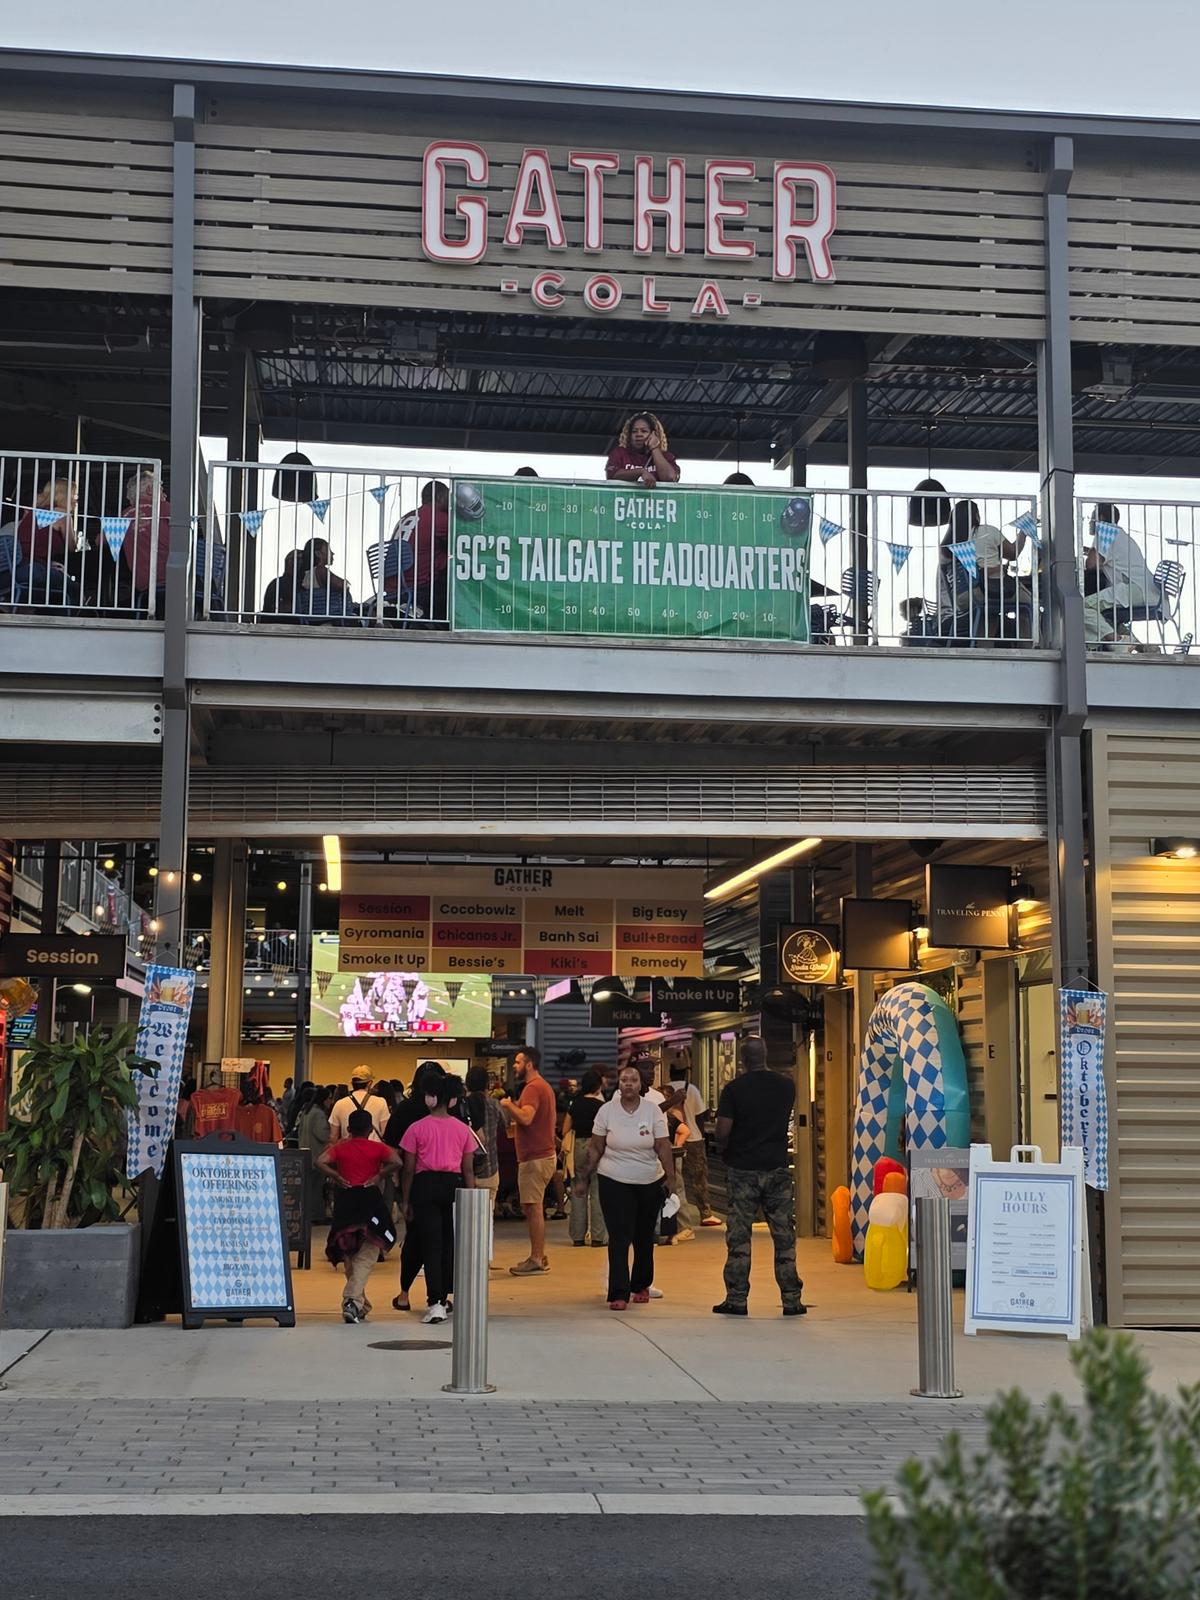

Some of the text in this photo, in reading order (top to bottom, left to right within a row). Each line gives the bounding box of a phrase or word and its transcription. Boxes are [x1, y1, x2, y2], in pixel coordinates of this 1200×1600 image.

[421, 140, 836, 284] GATHER
[614, 496, 677, 523] GATHER
[518, 536, 624, 585] TAILGATE
[633, 541, 806, 593] HEADQUARTERS
[627, 607, 640, 617] 50
[494, 867, 553, 888] GATHER
[358, 902, 412, 915] Session
[439, 903, 516, 916] Cocobowlz
[554, 905, 585, 917] Melt
[632, 906, 688, 921] Big Easy
[344, 926, 424, 941] Gyromania
[437, 928, 517, 942] Chicanos Jr.
[539, 930, 600, 943] Banh Sai
[623, 931, 697, 945] Bull+Bread
[26, 949, 98, 965] Session
[342, 952, 426, 969] Smoke It Up
[448, 955, 505, 969] Bessie's
[550, 956, 588, 970] Kiki's
[631, 956, 687, 971] Remedy
[657, 989, 734, 1003] Smoke It Up
[612, 1010, 641, 1020] Kiki's
[988, 1044, 996, 1060] E
[202, 1179, 258, 1191] OFFERINGS
[1004, 1190, 1046, 1202] DAILY
[1002, 1202, 1048, 1214] HOURS
